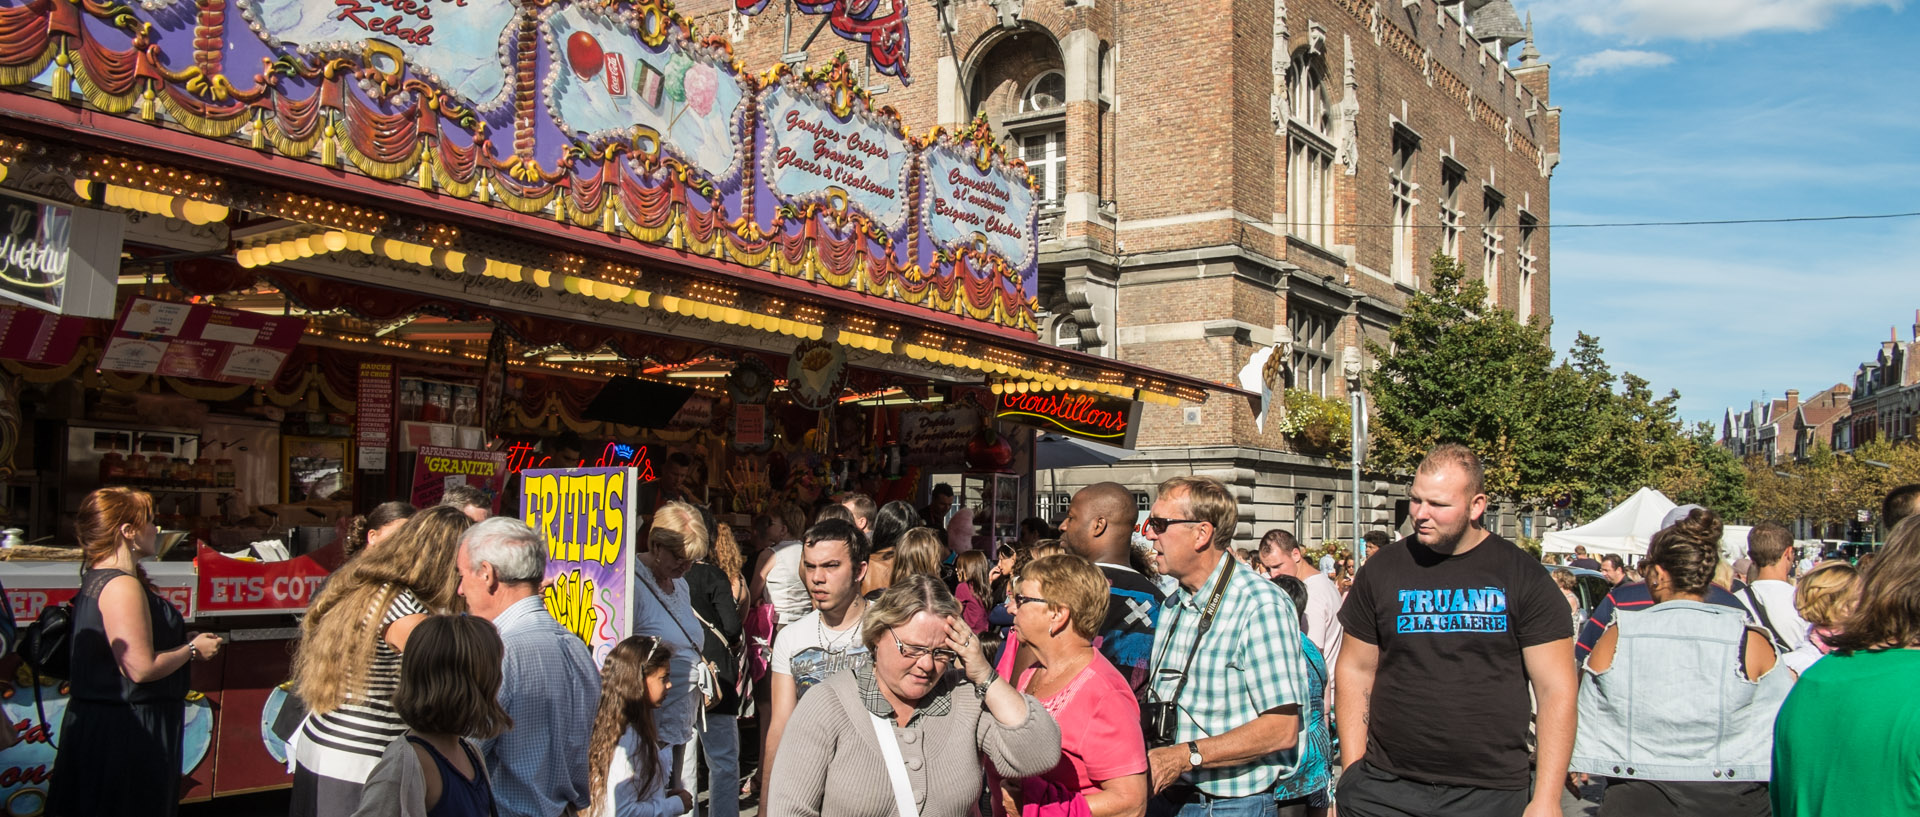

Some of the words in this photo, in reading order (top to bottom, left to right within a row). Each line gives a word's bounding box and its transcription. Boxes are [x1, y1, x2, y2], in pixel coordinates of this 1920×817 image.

[334, 0, 434, 46] Kebab
[813, 139, 865, 171] Granita
[776, 146, 822, 178] Glaces
[822, 163, 833, 180] à
[832, 165, 895, 200] l'italienne
[948, 167, 1011, 202] Croustillons
[360, 362, 392, 371] SAUCES
[1003, 392, 1127, 431] Croustillons
[473, 450, 490, 459] VOUS
[490, 451, 507, 462] AVEC
[524, 470, 625, 567] FRITES
[210, 577, 265, 603] ETS
[1207, 592, 1221, 615] Nikon
[1398, 587, 1506, 613] TRUAND
[1399, 617, 1411, 631] 2
[1413, 616, 1434, 631] LA
[1438, 615, 1505, 631] GALERE
